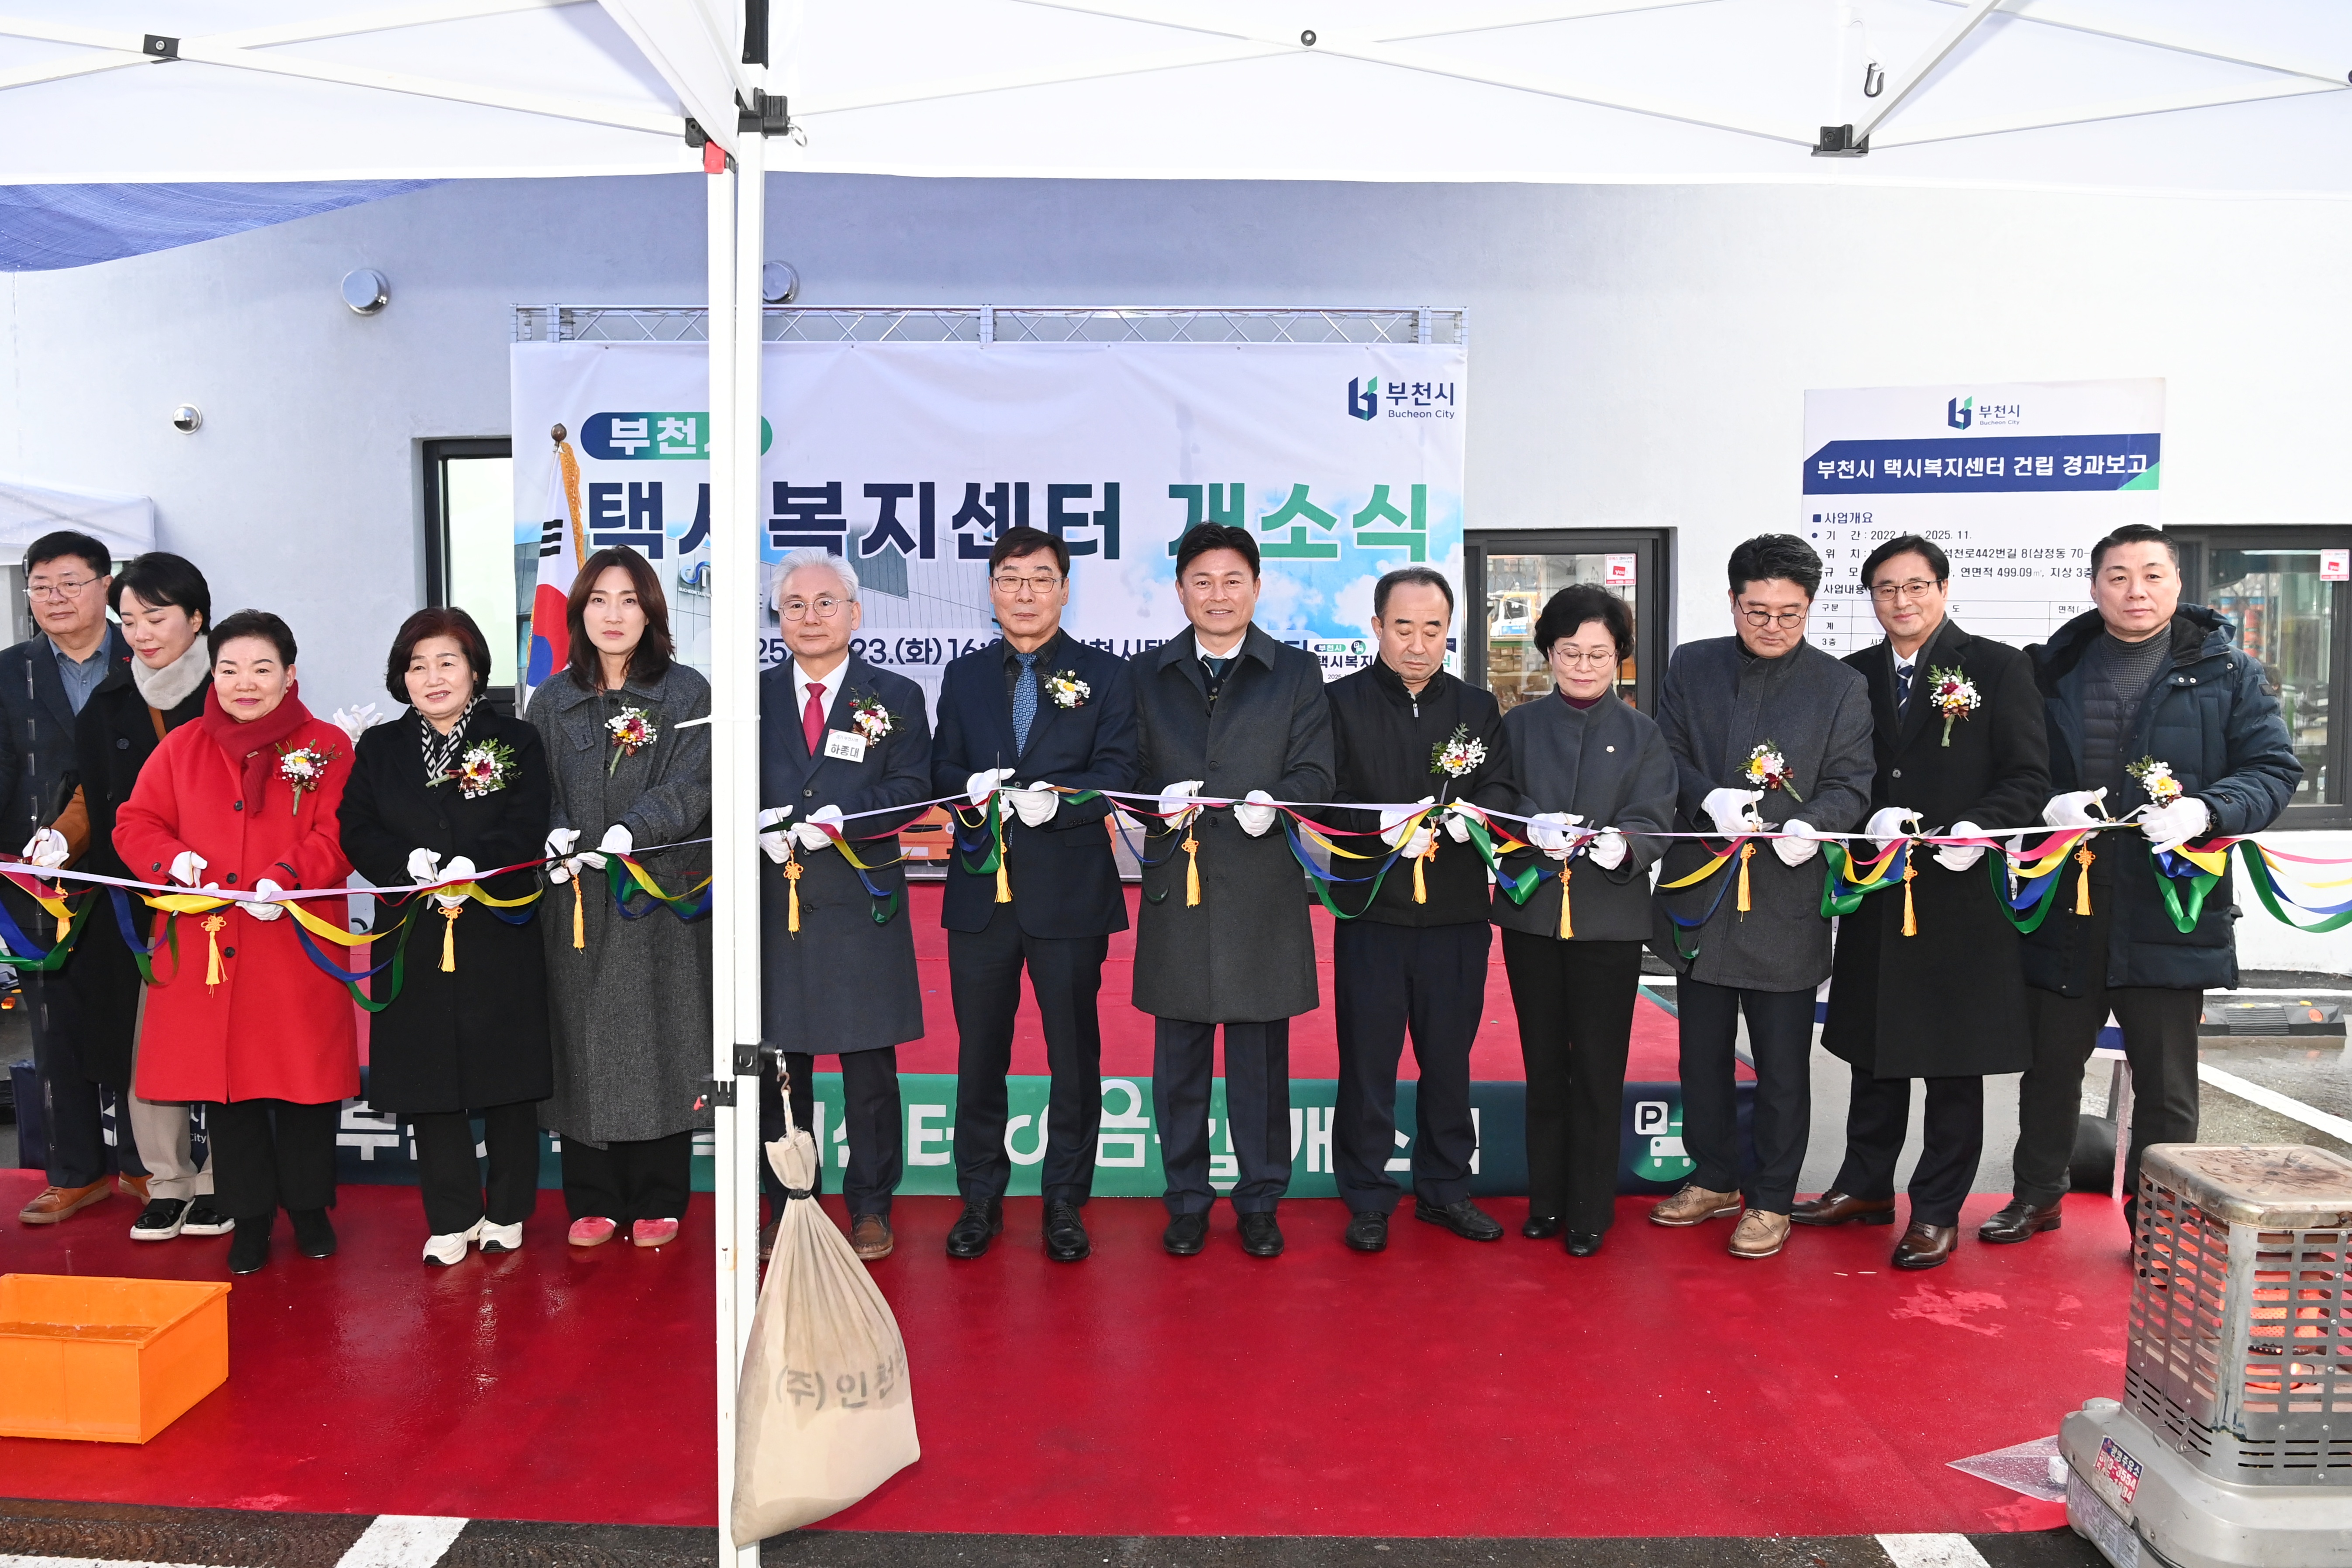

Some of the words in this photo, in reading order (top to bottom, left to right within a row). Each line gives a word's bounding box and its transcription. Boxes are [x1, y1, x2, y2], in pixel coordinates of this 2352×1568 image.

[1386, 382, 1454, 406] 부천시
[1388, 410, 1432, 418] Bucheon
[1435, 410, 1455, 419] City
[1978, 404, 2020, 418] 부천시
[610, 417, 710, 455] 부천
[1817, 458, 1875, 479] 부천시
[1883, 456, 2005, 479] 택시복지센터
[2013, 456, 2054, 477] 건립
[2062, 454, 2148, 476] 경과보고
[1824, 512, 1873, 524] 사업개요
[1924, 530, 1953, 540] 2025.
[1957, 530, 1972, 540] 11.
[1960, 567, 1993, 578] 연면적
[2050, 567, 2073, 578] 지상
[1824, 584, 1864, 594] 사업내용
[831, 744, 859, 758] 하종대
[2111, 1445, 2140, 1478] 광명주유소
